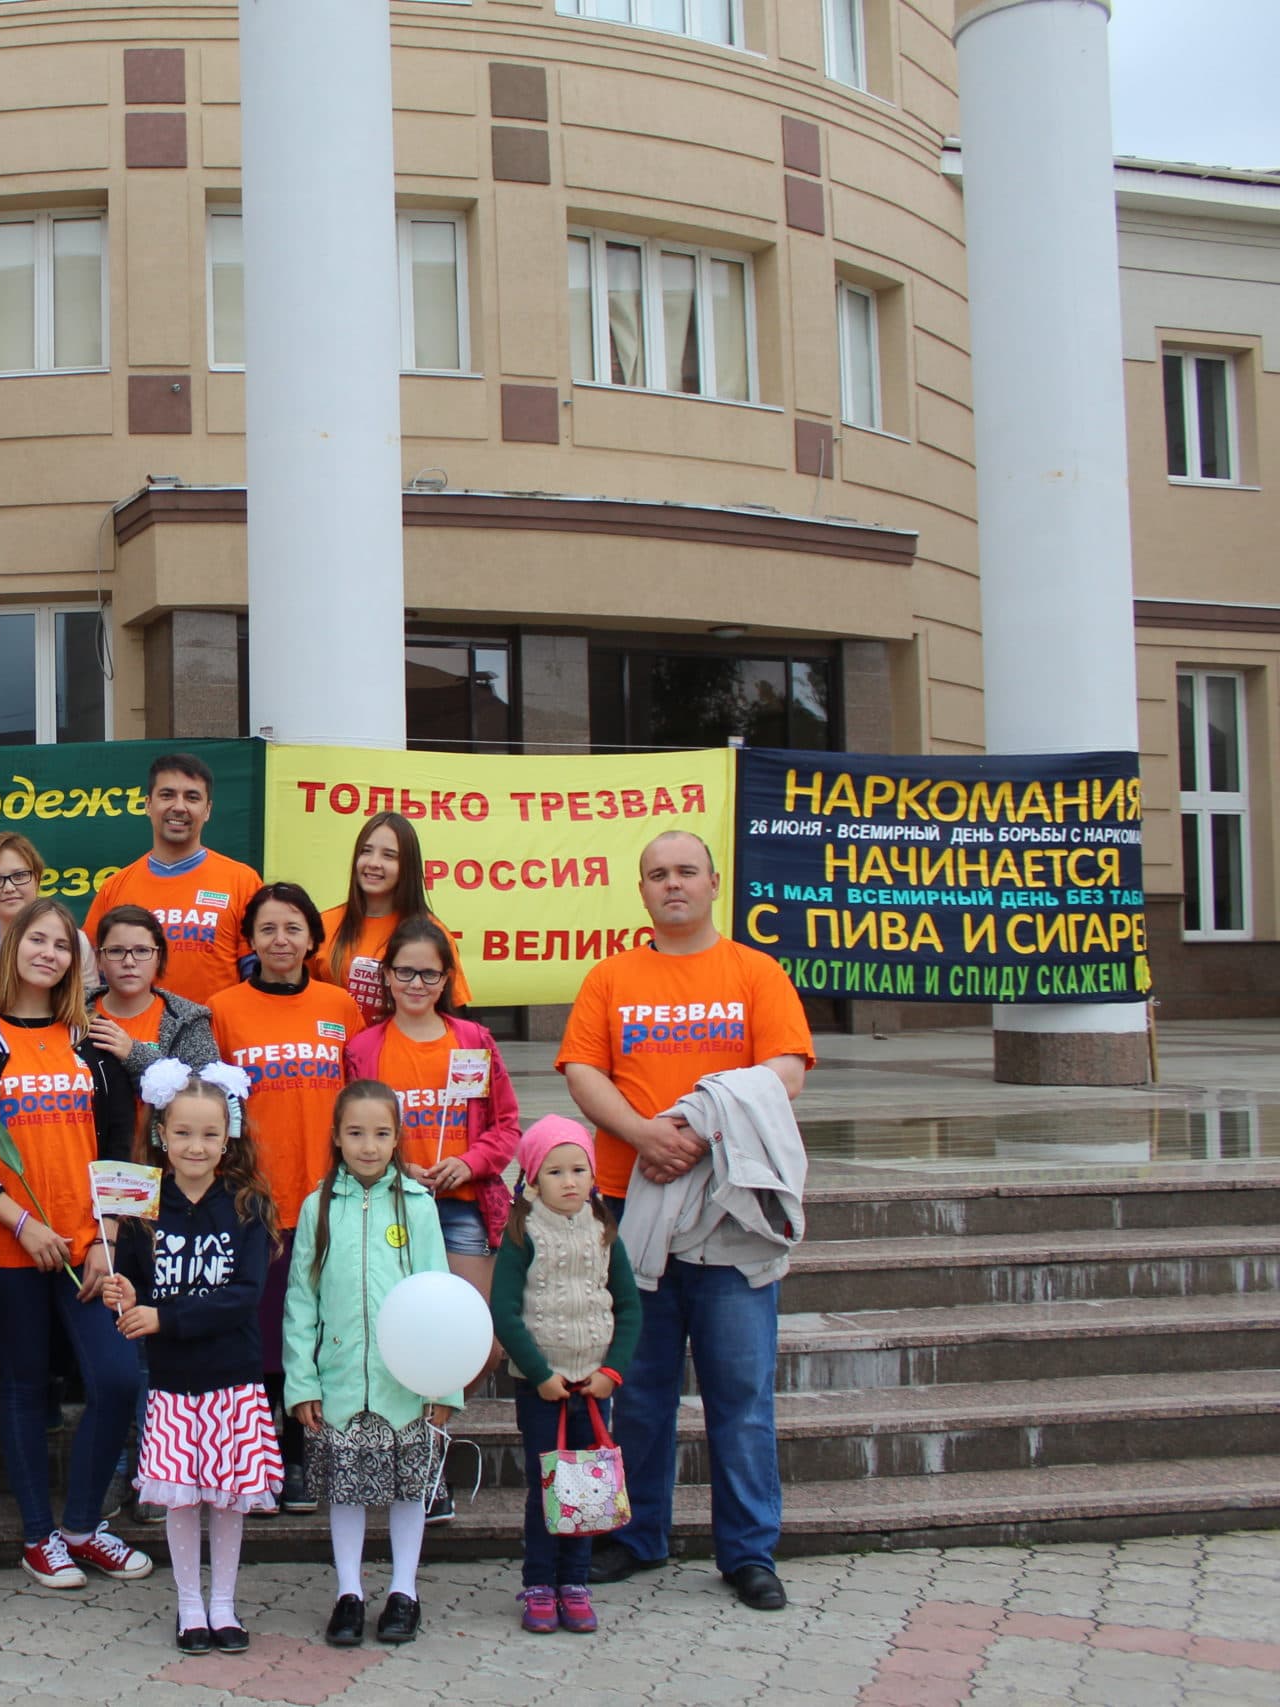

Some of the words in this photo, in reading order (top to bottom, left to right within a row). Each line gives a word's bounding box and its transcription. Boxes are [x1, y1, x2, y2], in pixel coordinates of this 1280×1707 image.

[297, 781, 489, 822] ТОЛЬКО
[510, 784, 706, 822] ТРЕЗВАЯ
[785, 769, 1143, 824] НАРКОМАНИЯ
[749, 820, 768, 835] 26
[771, 820, 822, 836] ИЮНЯ
[837, 824, 941, 841] ВСЕМИРНЫЙ
[950, 827, 994, 846] ДЕНЬ
[998, 827, 1067, 843] БОРЬБЫ
[1070, 829, 1081, 843] С
[424, 857, 609, 891] РОССИЯ
[825, 843, 1120, 887] НАЧИНАЕТСЯ
[749, 881, 774, 898] 31
[784, 885, 833, 902] МАЯ
[847, 888, 994, 905] ВСЕМИРНЫЙ
[1000, 891, 1059, 909] ДЕНЬ
[1066, 889, 1104, 905] БЕЗ
[747, 904, 779, 945] С
[806, 908, 944, 953] ПИВА
[963, 913, 997, 954] И
[925, 965, 939, 996] И
[949, 965, 1029, 1002] СПИДУ
[1037, 962, 1128, 995] СКАЖЕМ
[618, 1002, 745, 1023] ТРЕЗВАЯ
[233, 1043, 340, 1066] ТРЕЗВАЯ
[622, 1022, 745, 1055] РОССИЯ
[633, 1042, 692, 1054] ОБЩЕЕ
[699, 1041, 744, 1053] ДЕЛО
